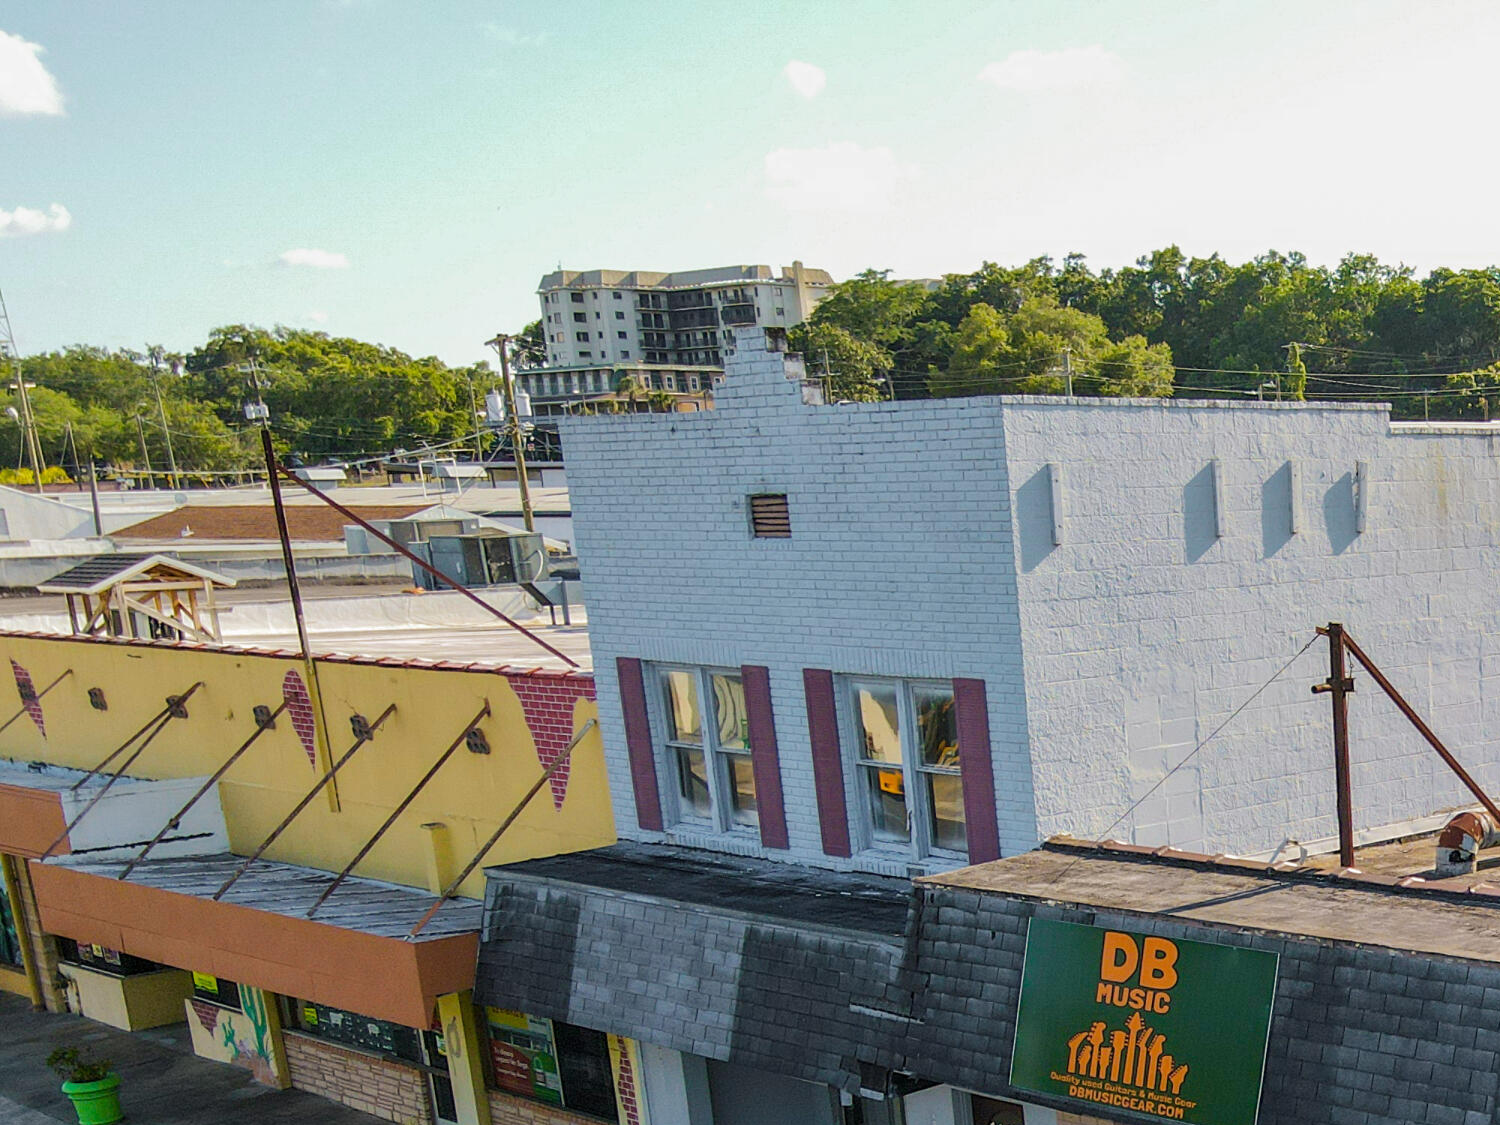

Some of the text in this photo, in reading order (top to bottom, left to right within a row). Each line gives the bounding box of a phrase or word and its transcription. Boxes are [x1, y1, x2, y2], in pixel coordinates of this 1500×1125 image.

[1100, 931, 1179, 990] DB
[1096, 982, 1171, 1014] MUSIC
[1069, 1085, 1185, 1120] DBMUSICGEAR.COM
